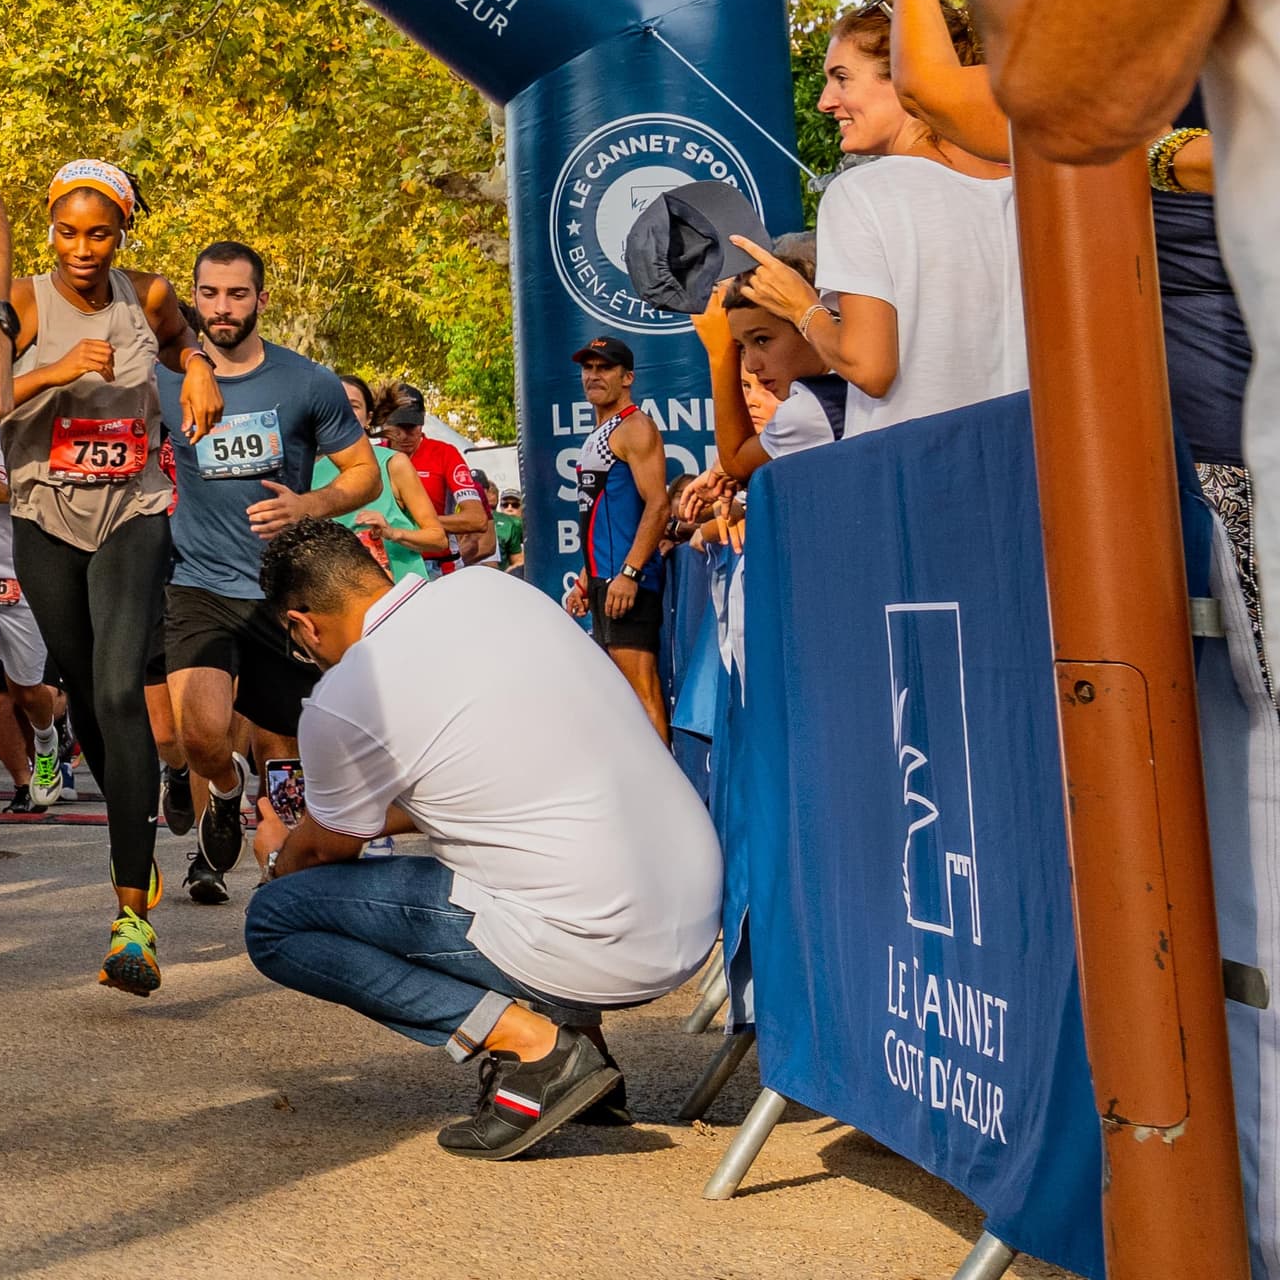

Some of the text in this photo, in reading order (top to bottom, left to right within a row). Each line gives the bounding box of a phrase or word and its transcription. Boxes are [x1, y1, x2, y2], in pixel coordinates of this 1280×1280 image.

[569, 134, 742, 209] LE CANNET SPOR
[552, 402, 594, 436] LE
[73, 440, 128, 467] 753
[213, 434, 263, 461] 549
[887, 945, 909, 1020] LE
[929, 1056, 1008, 1145] D'AZUR
